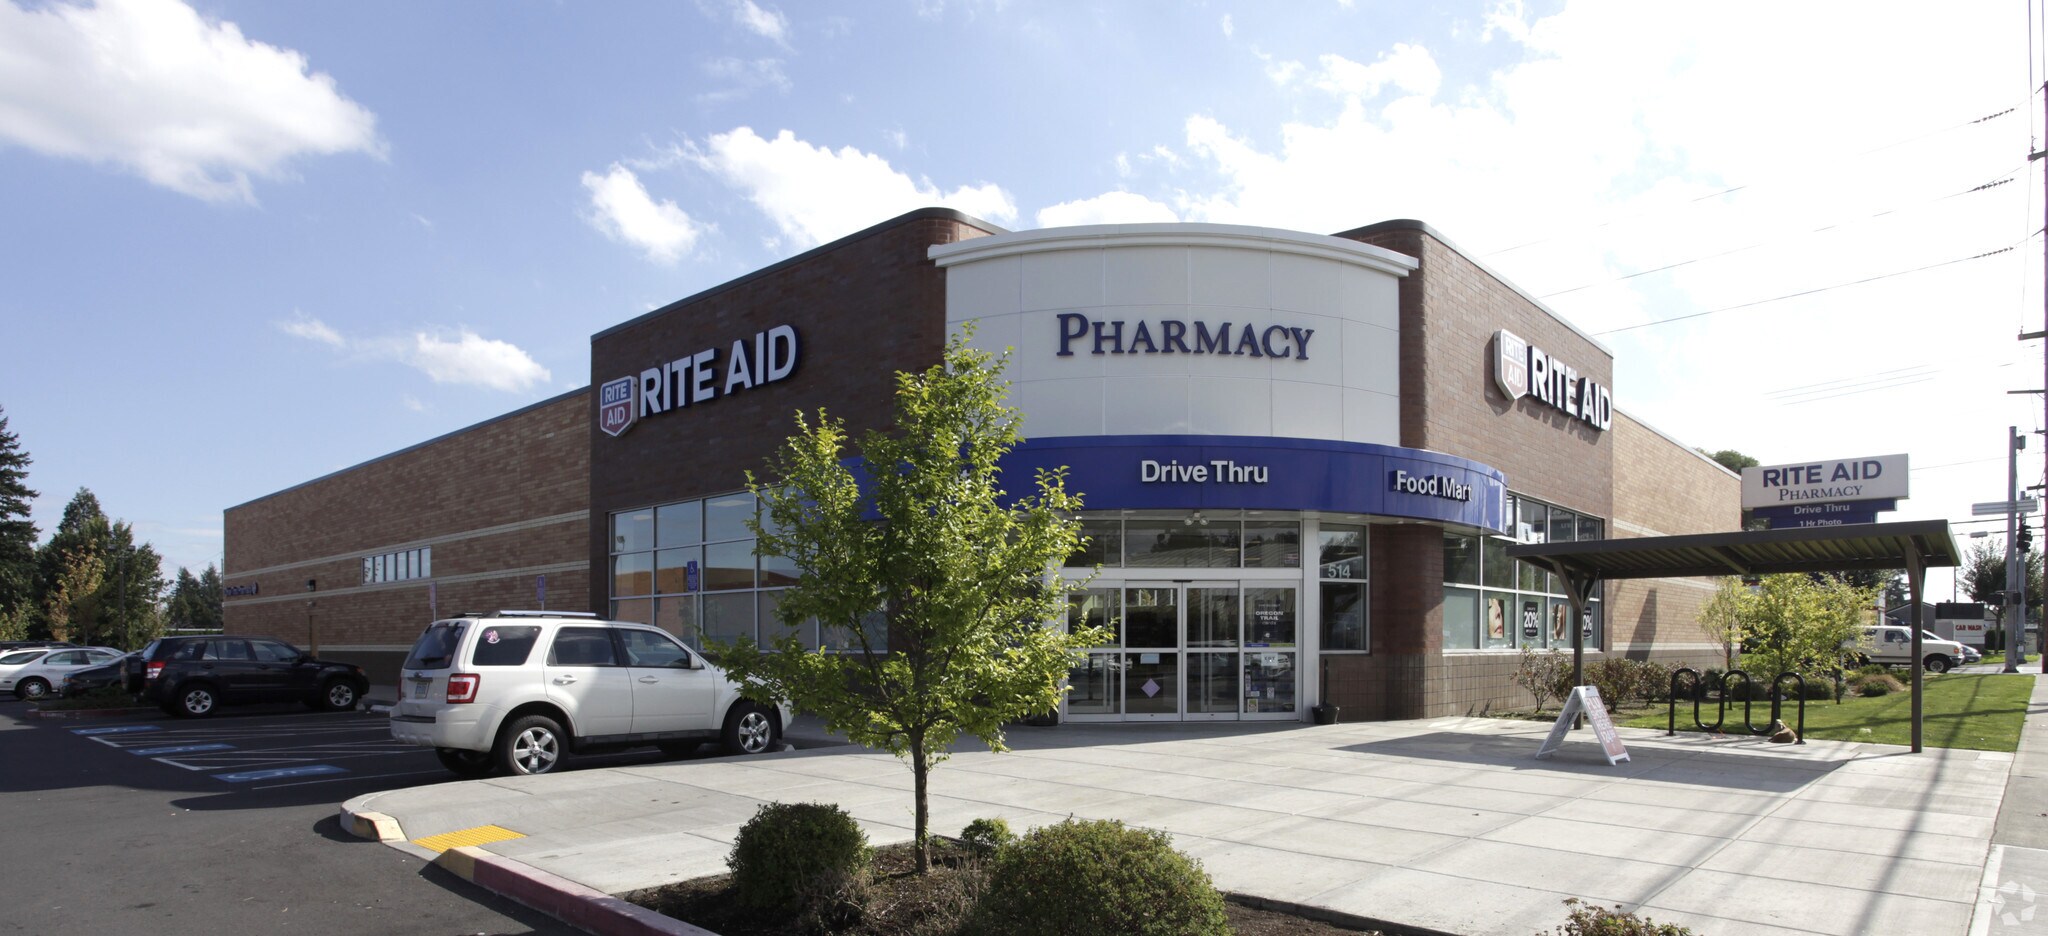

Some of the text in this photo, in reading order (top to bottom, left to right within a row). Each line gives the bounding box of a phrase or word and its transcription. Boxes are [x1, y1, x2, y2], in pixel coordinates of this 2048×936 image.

[1505, 336, 1525, 362] RITE
[640, 324, 797, 418] RITE AID
[1507, 365, 1523, 388] AID
[605, 382, 628, 403] RITE
[1531, 345, 1612, 431] RITE AID
[607, 406, 626, 427] AID
[1141, 460, 1268, 483] Drive Thru
[1763, 460, 1882, 488] RITE AID
[1396, 470, 1472, 501] Food Mart
[1793, 503, 1850, 515] Drive Thru
[1328, 564, 1350, 578] 514
[1524, 611, 1539, 628] 20%
